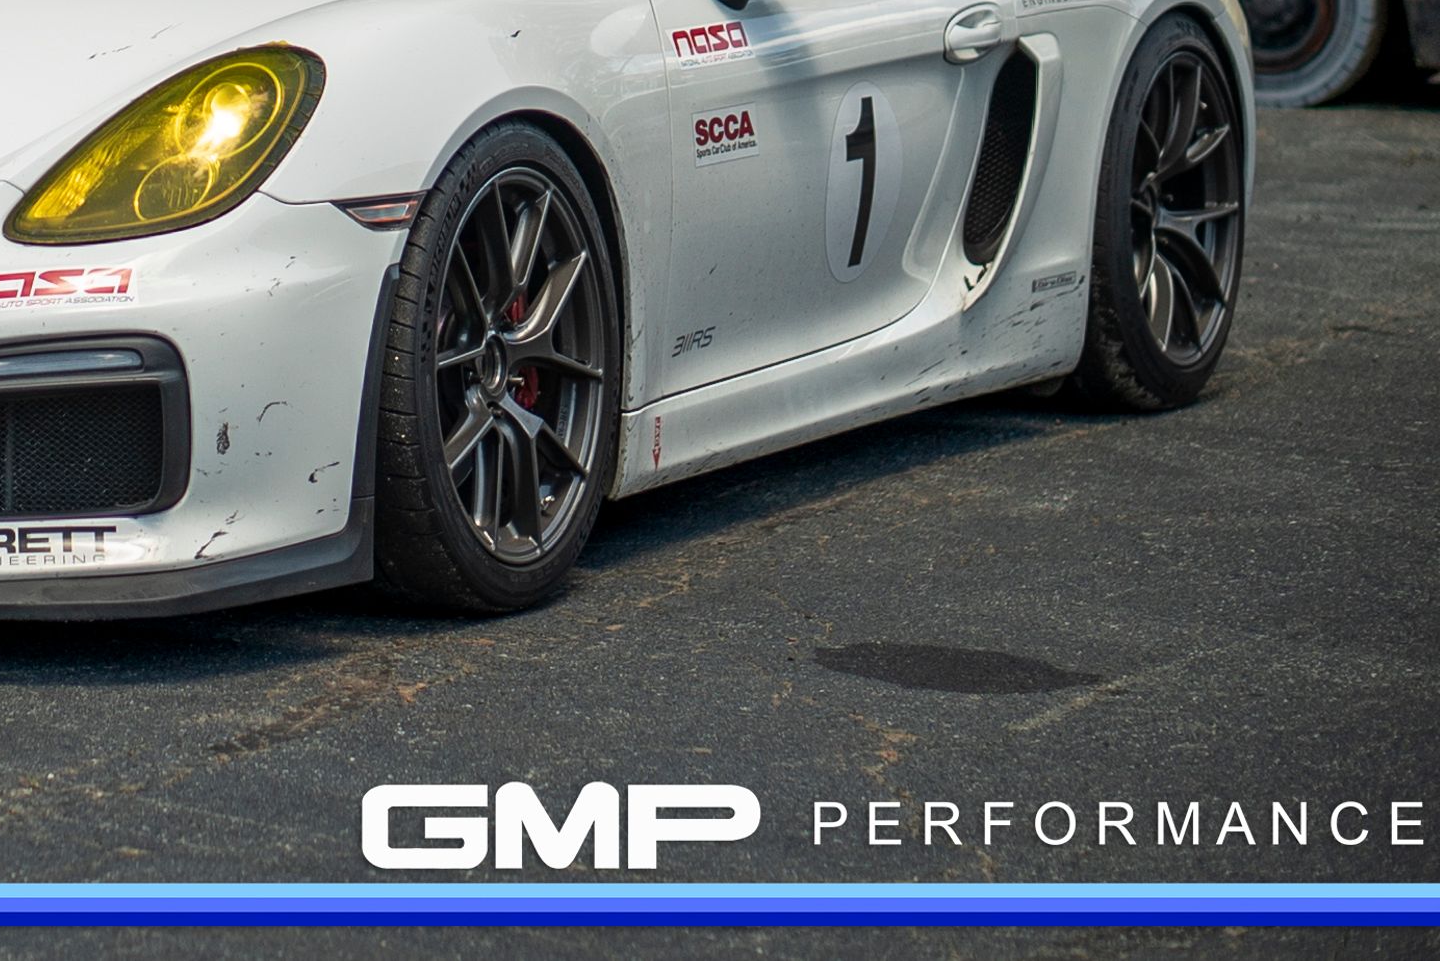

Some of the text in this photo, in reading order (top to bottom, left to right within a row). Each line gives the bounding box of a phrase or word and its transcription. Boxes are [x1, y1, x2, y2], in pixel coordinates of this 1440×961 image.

[695, 110, 755, 146] SCCA
[845, 96, 877, 268] 1
[26, 297, 62, 306] SPORT
[64, 295, 135, 304] ASSOCIATION
